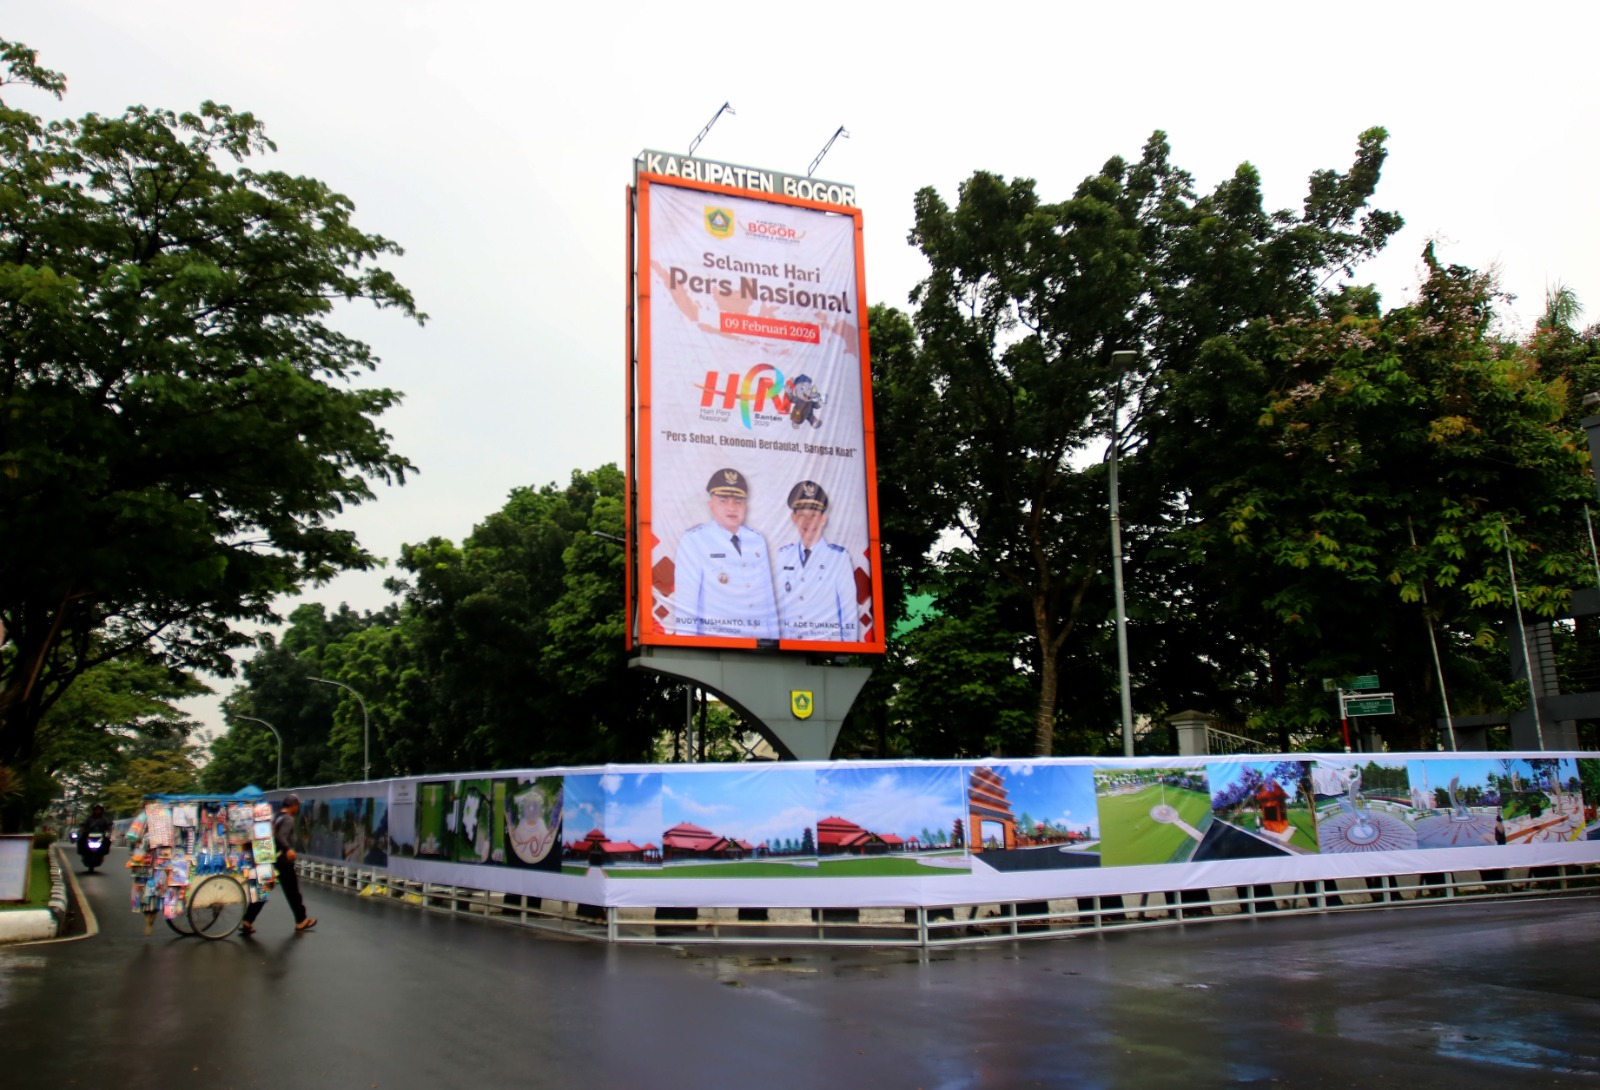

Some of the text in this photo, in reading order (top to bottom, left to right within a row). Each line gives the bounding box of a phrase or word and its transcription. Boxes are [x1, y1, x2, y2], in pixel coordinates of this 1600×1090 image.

[647, 152, 856, 207] KABUPATEN BOGOR
[748, 222, 796, 238] BOGOR
[703, 252, 821, 283] Selamat Hari
[669, 267, 852, 314] Pers Nasional
[724, 317, 816, 339] 09 Februari 2026
[754, 413, 783, 422] Banten
[689, 433, 717, 446] Sehat,
[719, 435, 757, 449] Ekonomi
[759, 439, 802, 453] Berdaulat,
[804, 443, 834, 456] Bangsa
[675, 617, 697, 625] RUDY
[809, 622, 844, 630] RUHAND,
